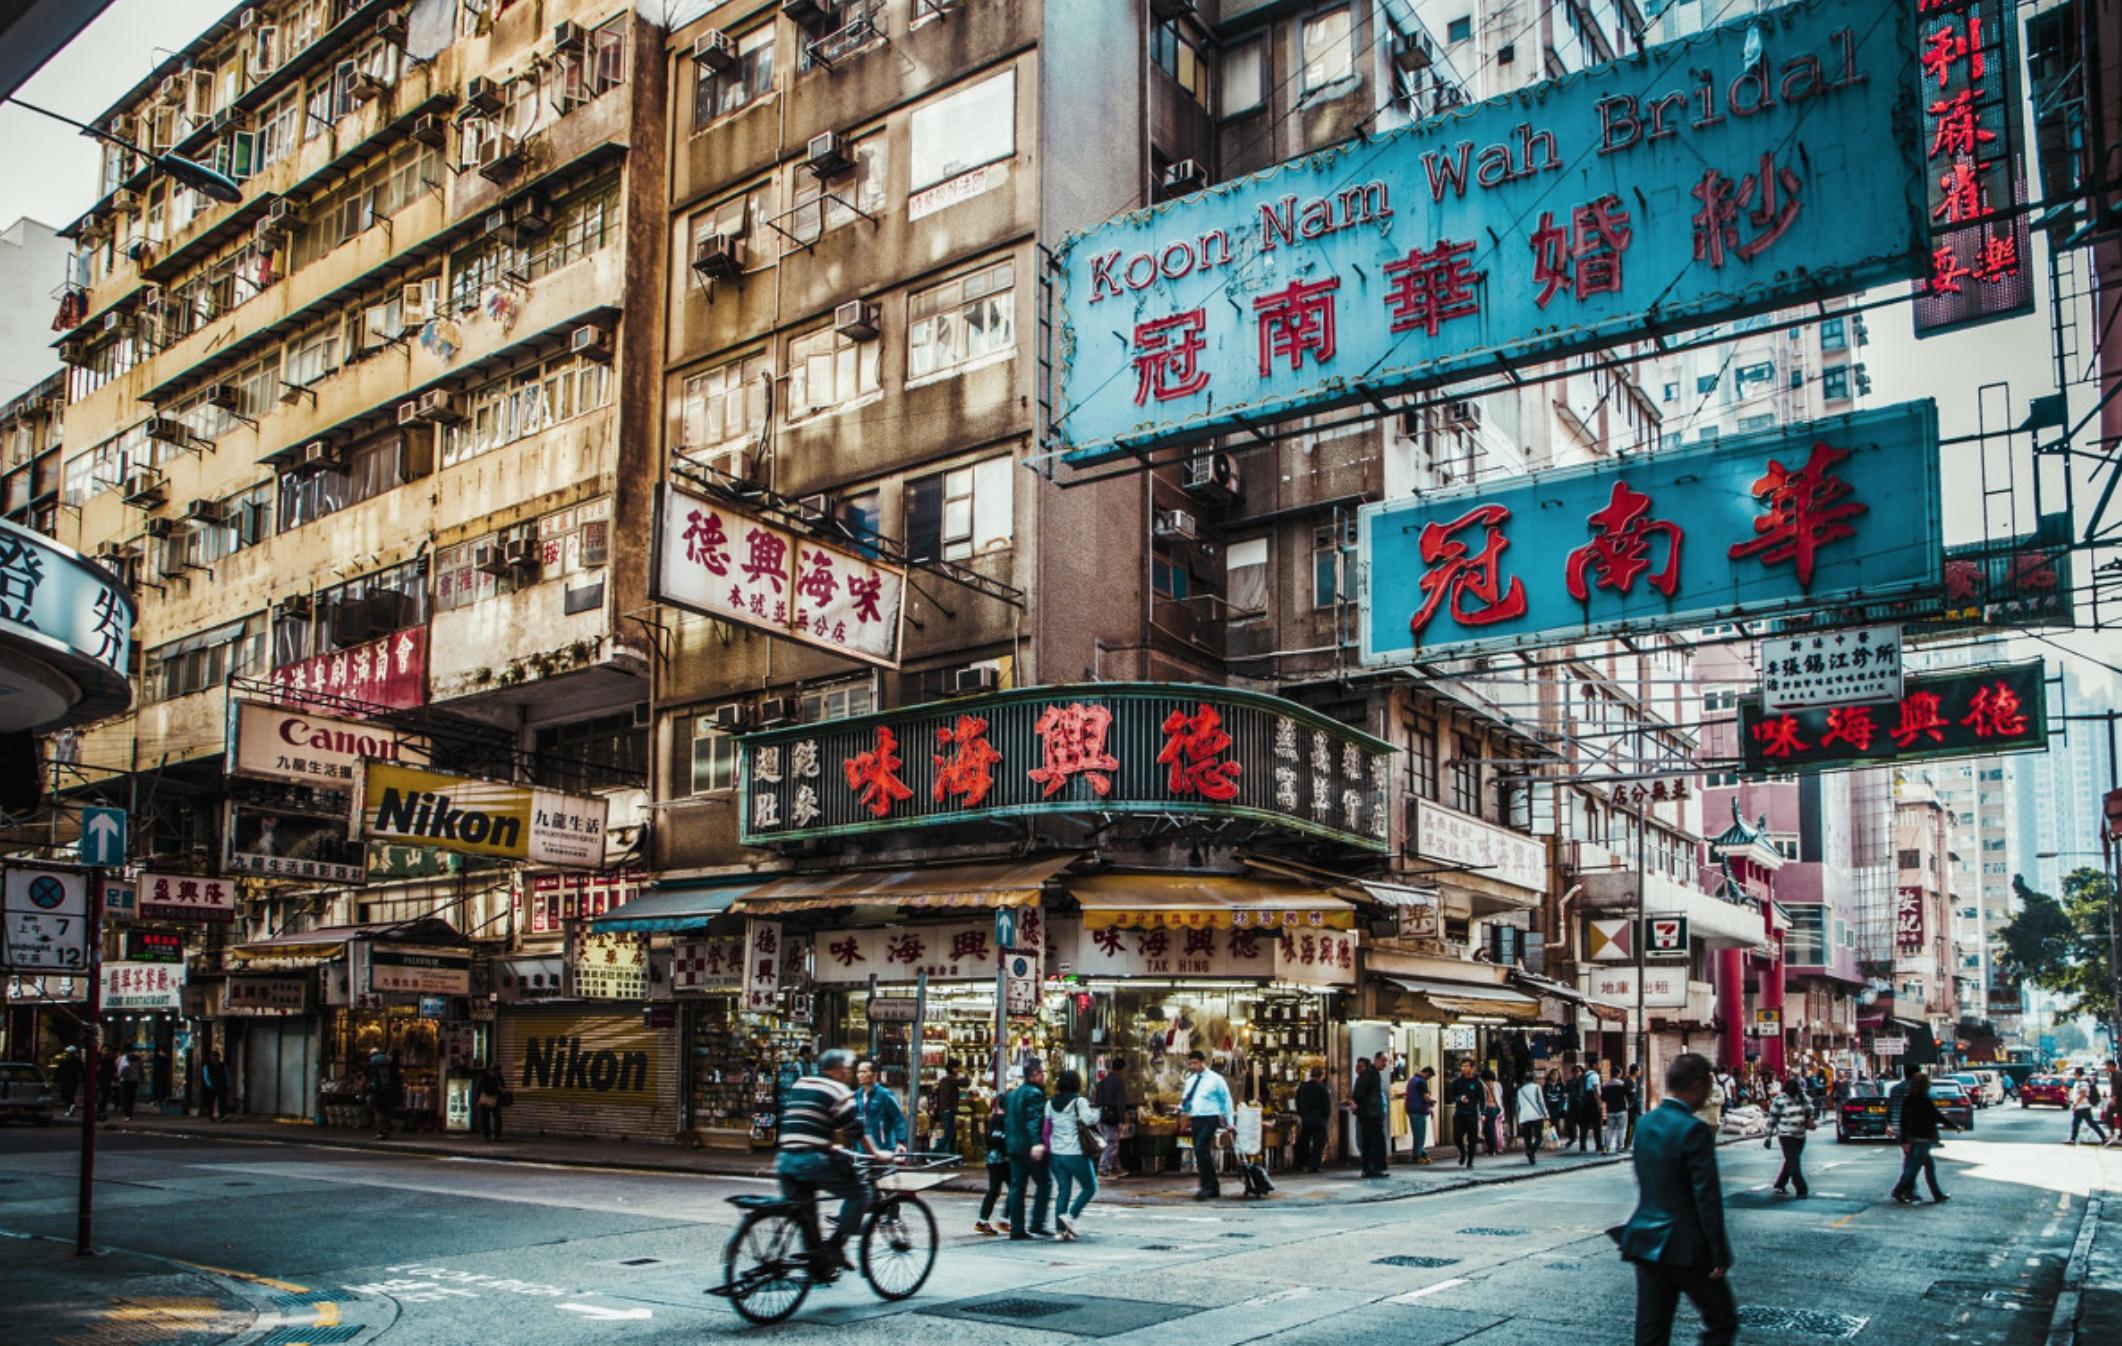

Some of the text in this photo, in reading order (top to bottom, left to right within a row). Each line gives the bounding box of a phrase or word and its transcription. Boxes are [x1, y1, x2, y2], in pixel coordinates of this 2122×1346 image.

[1088, 26, 1870, 304] Koon Nam Wah Bridal
[1132, 150, 1802, 408] 冠南華婚紗
[1409, 440, 1869, 625] 冠南華
[682, 509, 883, 624] 德興海味
[279, 718, 399, 762] Canon
[374, 786, 522, 848] Nikon
[535, 808, 600, 834] 九龍生活
[152, 878, 225, 904] 盈興隆
[56, 919, 70, 936] 7
[55, 947, 80, 965] 12
[1147, 959, 1209, 973] TAK HING
[1601, 980, 1630, 994] 地庫
[522, 1036, 647, 1093] Nikon
